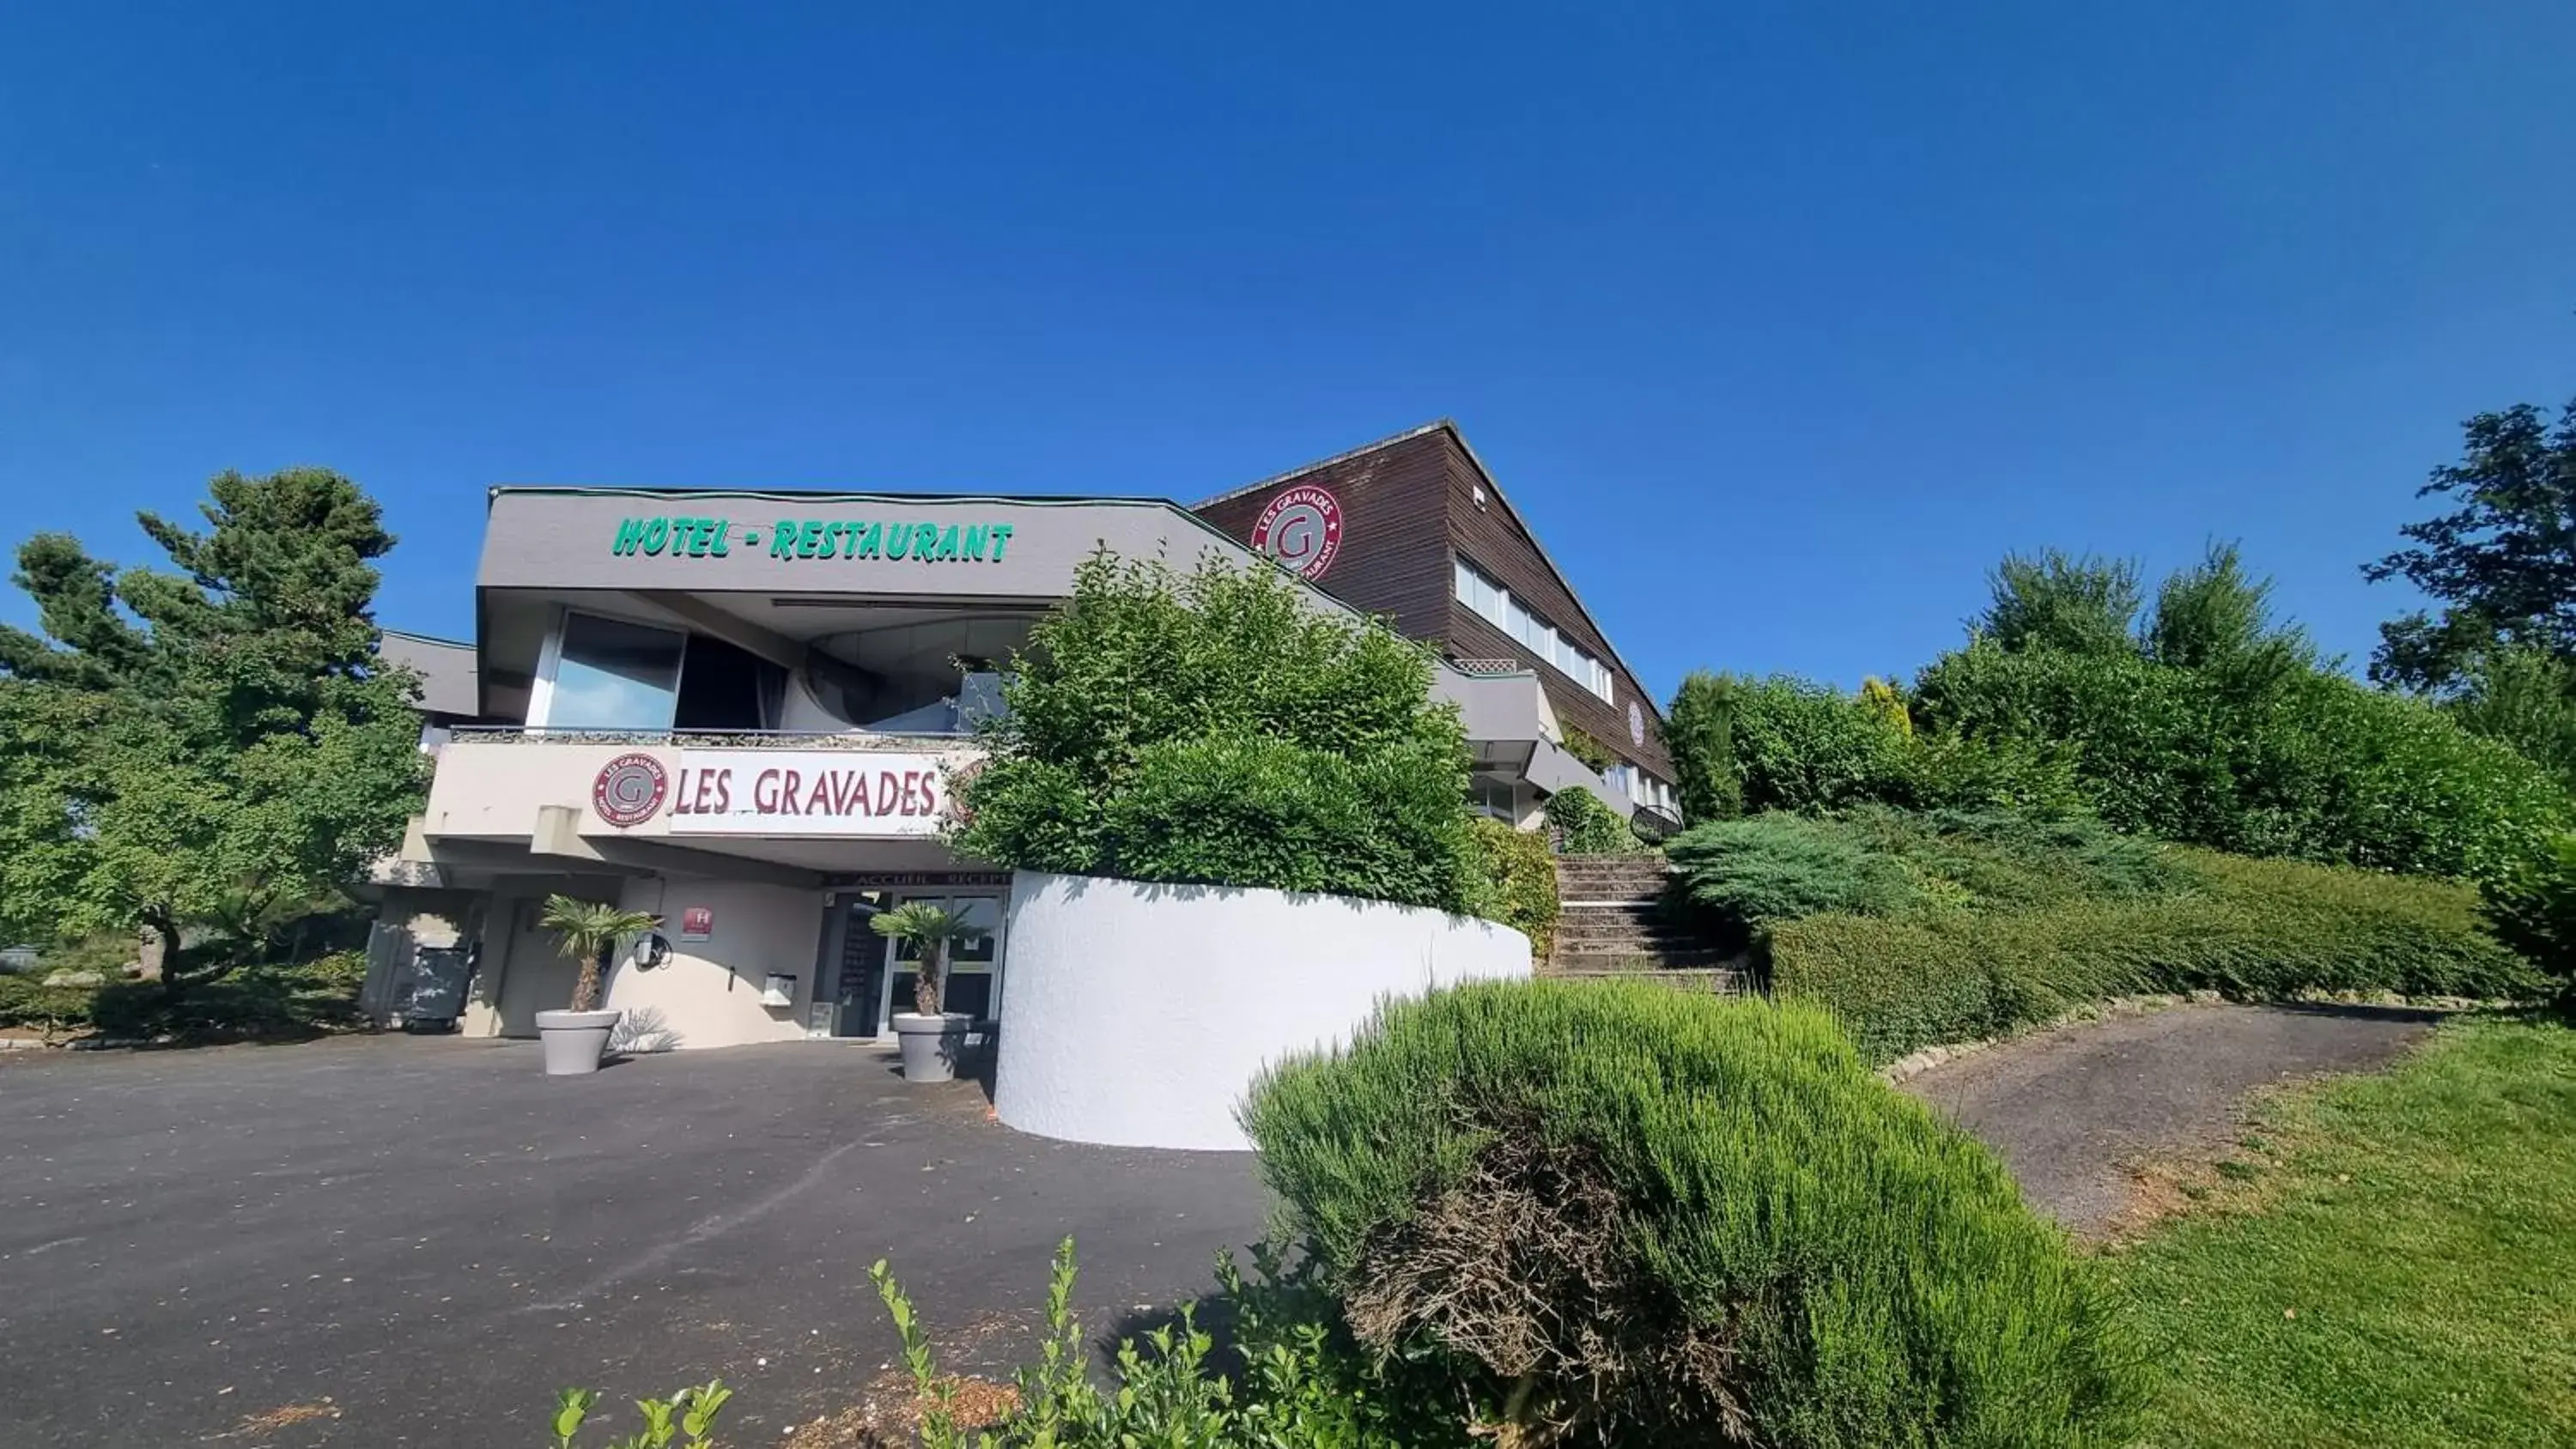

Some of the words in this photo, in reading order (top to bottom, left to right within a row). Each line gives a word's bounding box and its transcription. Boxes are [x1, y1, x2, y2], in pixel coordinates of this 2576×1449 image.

[1260, 509, 1277, 531] LES
[1277, 491, 1334, 515] GRAVADES
[613, 517, 732, 557] HOTEL
[770, 519, 1013, 563] RESTAURANT
[1277, 514, 1312, 561] G
[1302, 540, 1334, 579] AURANT
[619, 758, 661, 779] GRAVADES
[615, 774, 642, 803] G
[675, 769, 732, 815] LES
[754, 768, 936, 816] GRAVADES
[858, 873, 930, 885] ACCUEIL
